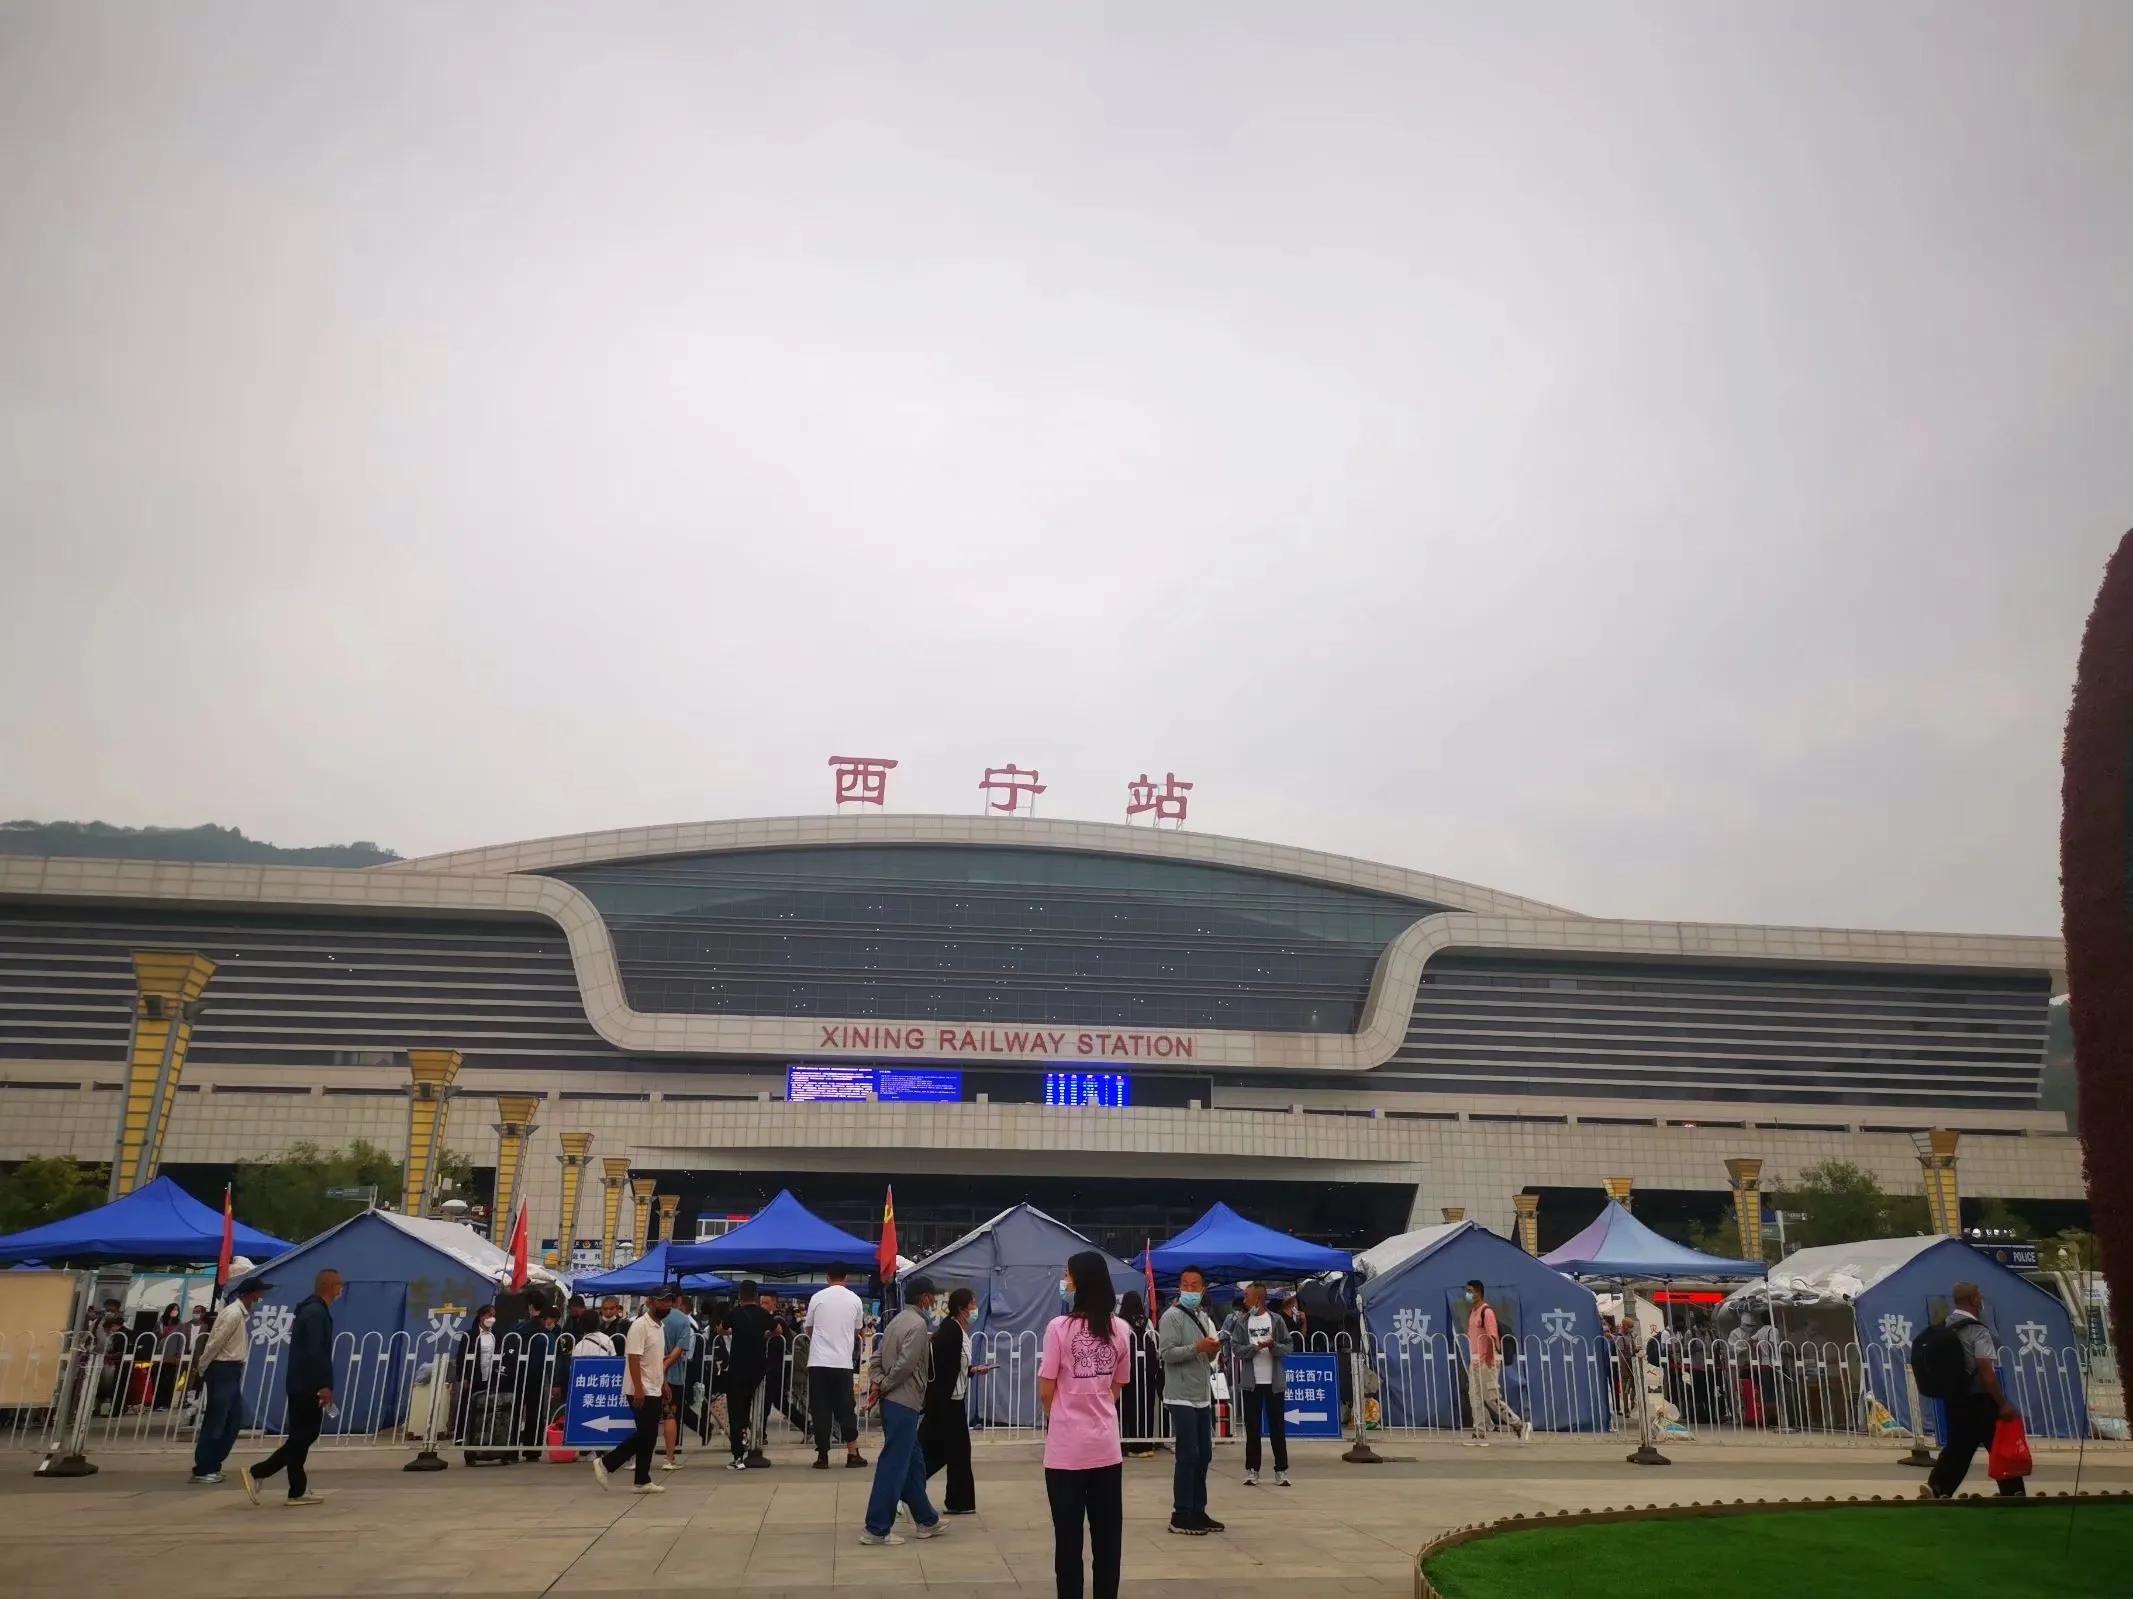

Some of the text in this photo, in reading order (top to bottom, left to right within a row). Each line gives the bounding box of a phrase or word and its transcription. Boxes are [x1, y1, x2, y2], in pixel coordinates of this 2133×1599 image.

[828, 755, 1194, 822] 西宁站
[820, 1026, 1194, 1058] XINING RAILWAY STATION
[2013, 1251, 2036, 1263] POLICE
[251, 1302, 469, 1345] 救 灾
[1392, 1308, 1579, 1345] 救 灾
[1878, 1313, 1913, 1349] 救
[2015, 1320, 2051, 1356] 灾
